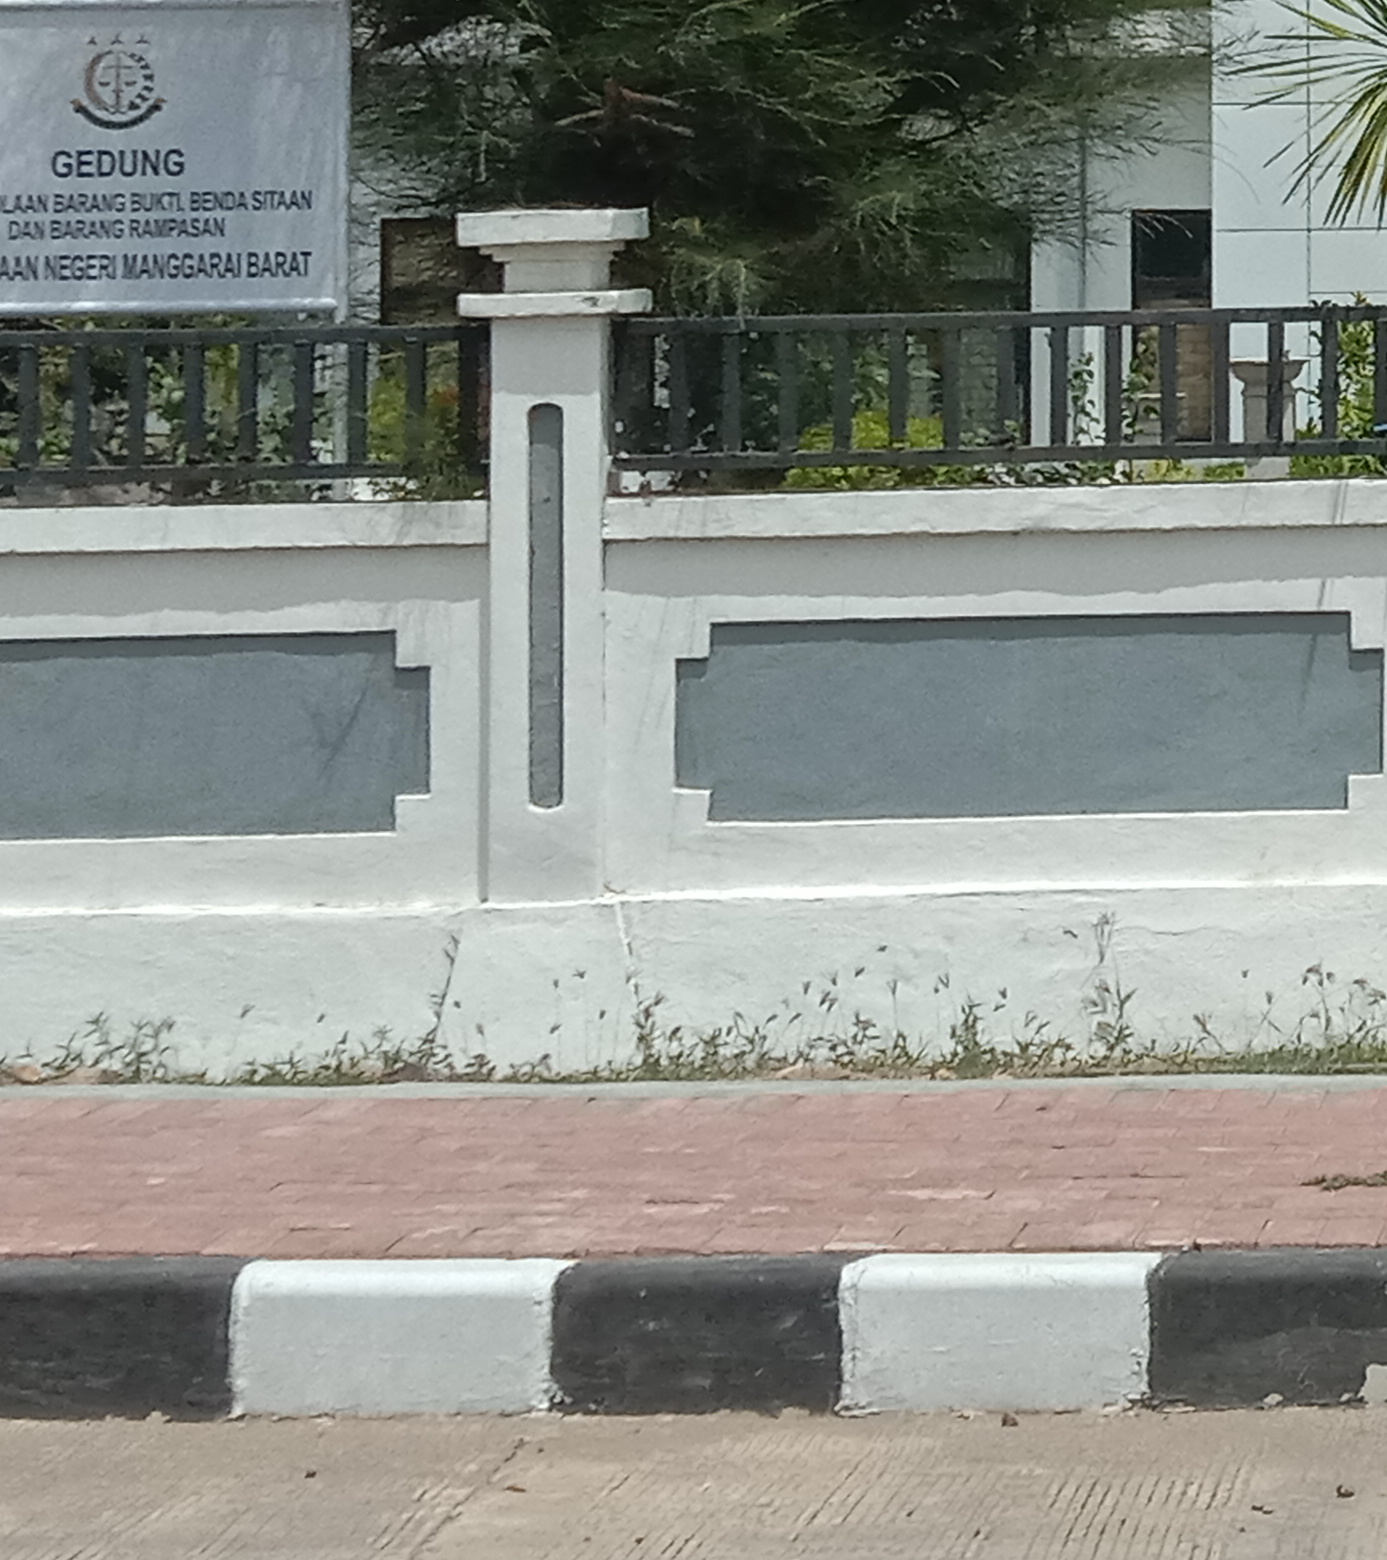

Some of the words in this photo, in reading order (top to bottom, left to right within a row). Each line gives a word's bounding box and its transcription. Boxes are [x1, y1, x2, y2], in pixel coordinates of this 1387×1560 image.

[51, 148, 186, 178] GEDUNG
[53, 192, 126, 214] BARANG
[190, 191, 249, 212] BENDA
[252, 189, 313, 211] SITAAN
[8, 219, 45, 240] DAN
[50, 218, 125, 240] BARANG
[129, 217, 226, 239] RAMPASAN
[44, 253, 117, 281] NEGERI
[121, 251, 242, 280] MANGGARAI
[246, 250, 312, 279] BARAT
